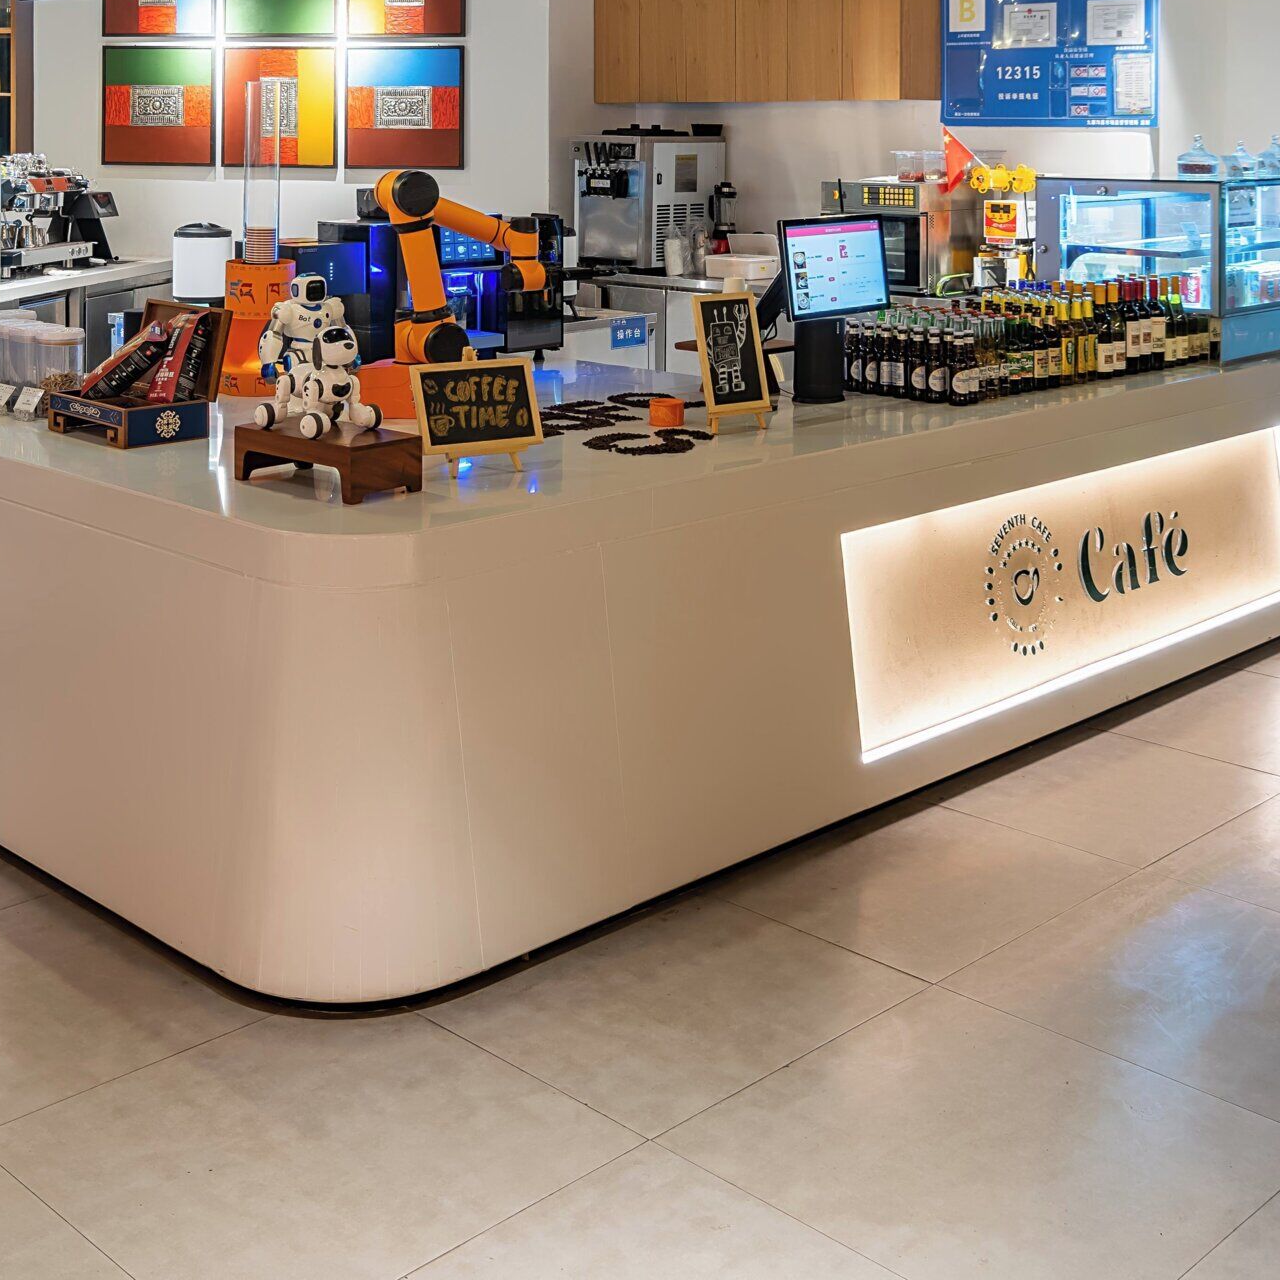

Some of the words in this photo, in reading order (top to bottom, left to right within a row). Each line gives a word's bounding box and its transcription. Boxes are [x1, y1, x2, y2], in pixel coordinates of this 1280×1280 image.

[996, 65, 1041, 80] 12315
[298, 314, 311, 323] Bot
[617, 327, 641, 340] 操作台
[444, 375, 519, 403] COFFEE
[450, 404, 512, 430] TIME
[990, 513, 1026, 556] SEVENTH
[1030, 516, 1053, 544] CAFE
[1077, 509, 1189, 603] Café
